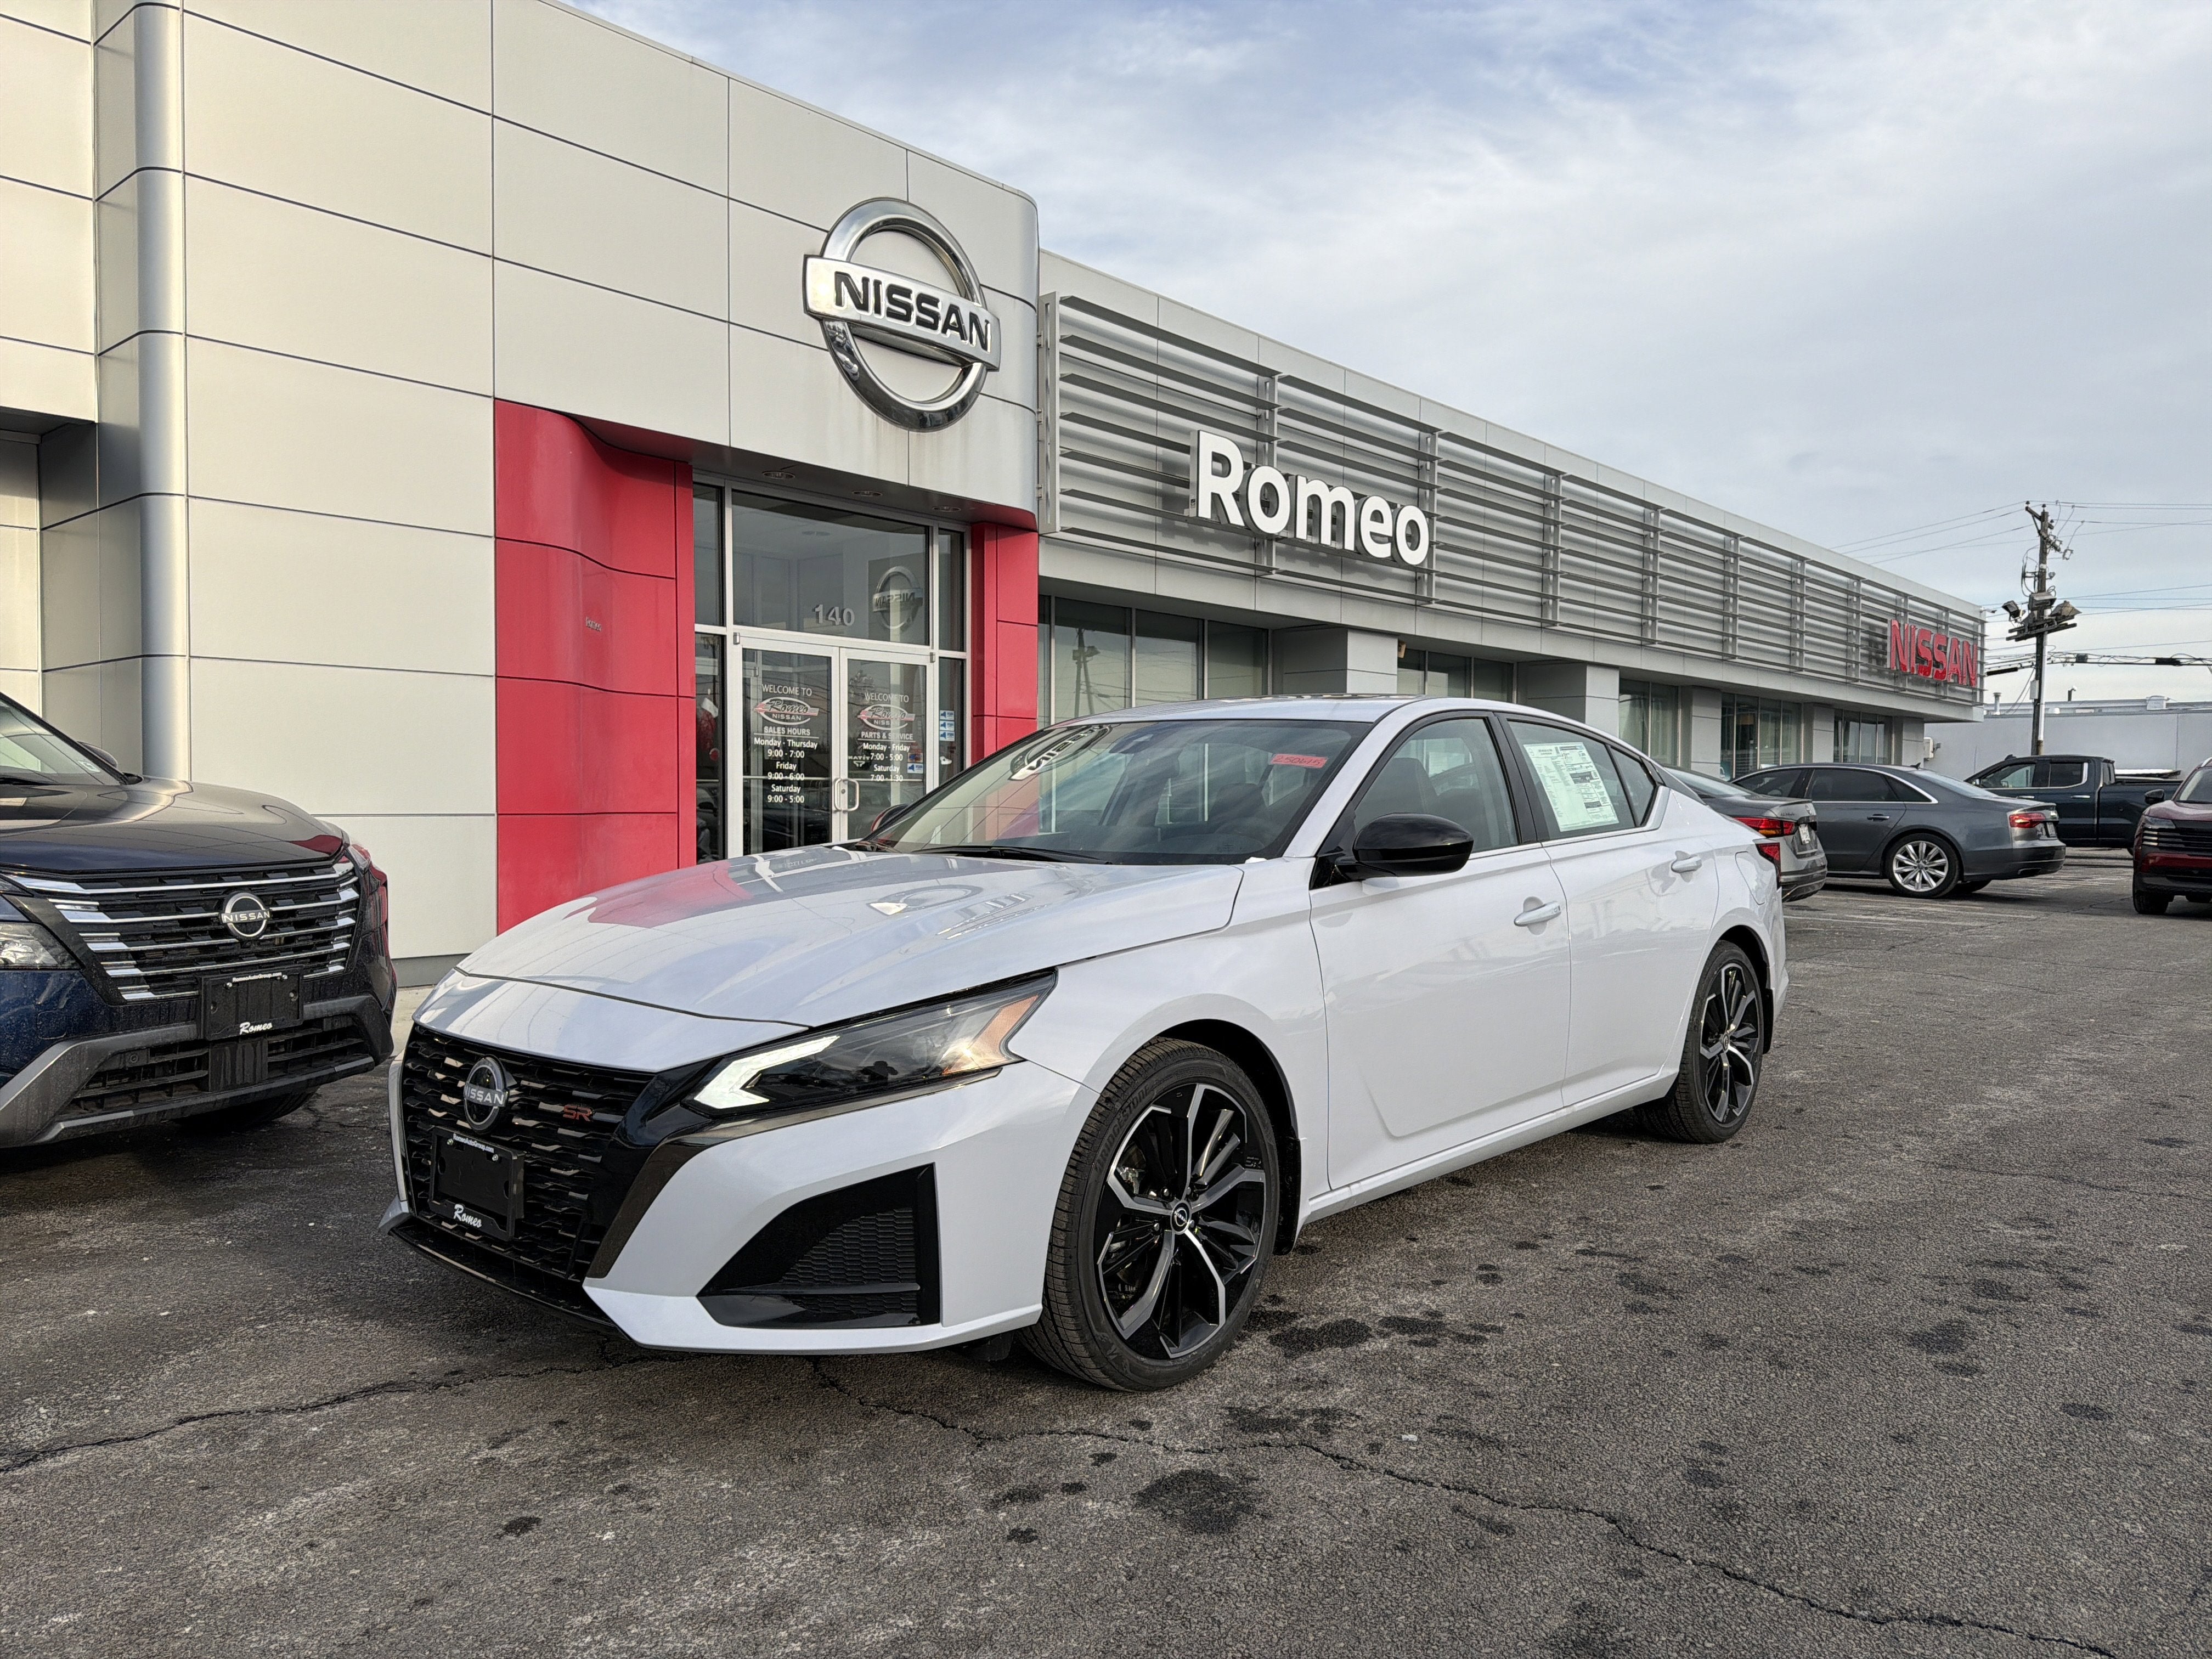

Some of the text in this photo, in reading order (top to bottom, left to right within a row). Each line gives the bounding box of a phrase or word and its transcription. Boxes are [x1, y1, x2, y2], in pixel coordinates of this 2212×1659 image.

[834, 271, 991, 354] NISSAN
[1195, 430, 1429, 566] Romeo
[815, 604, 855, 626] 140
[1891, 619, 1978, 688] NISSAN
[761, 684, 812, 696] WELCOME TO
[865, 692, 898, 702] WELCOME
[766, 698, 809, 713] Romeo
[754, 737, 781, 747] Monday
[787, 739, 817, 749] Thursday
[863, 743, 887, 752] Monday
[892, 744, 910, 752] Friday
[768, 749, 783, 757] 9:00
[776, 761, 797, 771] Friday
[873, 764, 900, 773] Saturday
[771, 784, 800, 793] Saturday
[223, 911, 270, 922] NISSAN
[233, 972, 282, 982] RomeoAutoGroup.com
[239, 1022, 273, 1035] Romeo
[464, 1086, 504, 1105] NISSAN
[563, 1105, 592, 1121] SR
[453, 1204, 482, 1228] Romeo
